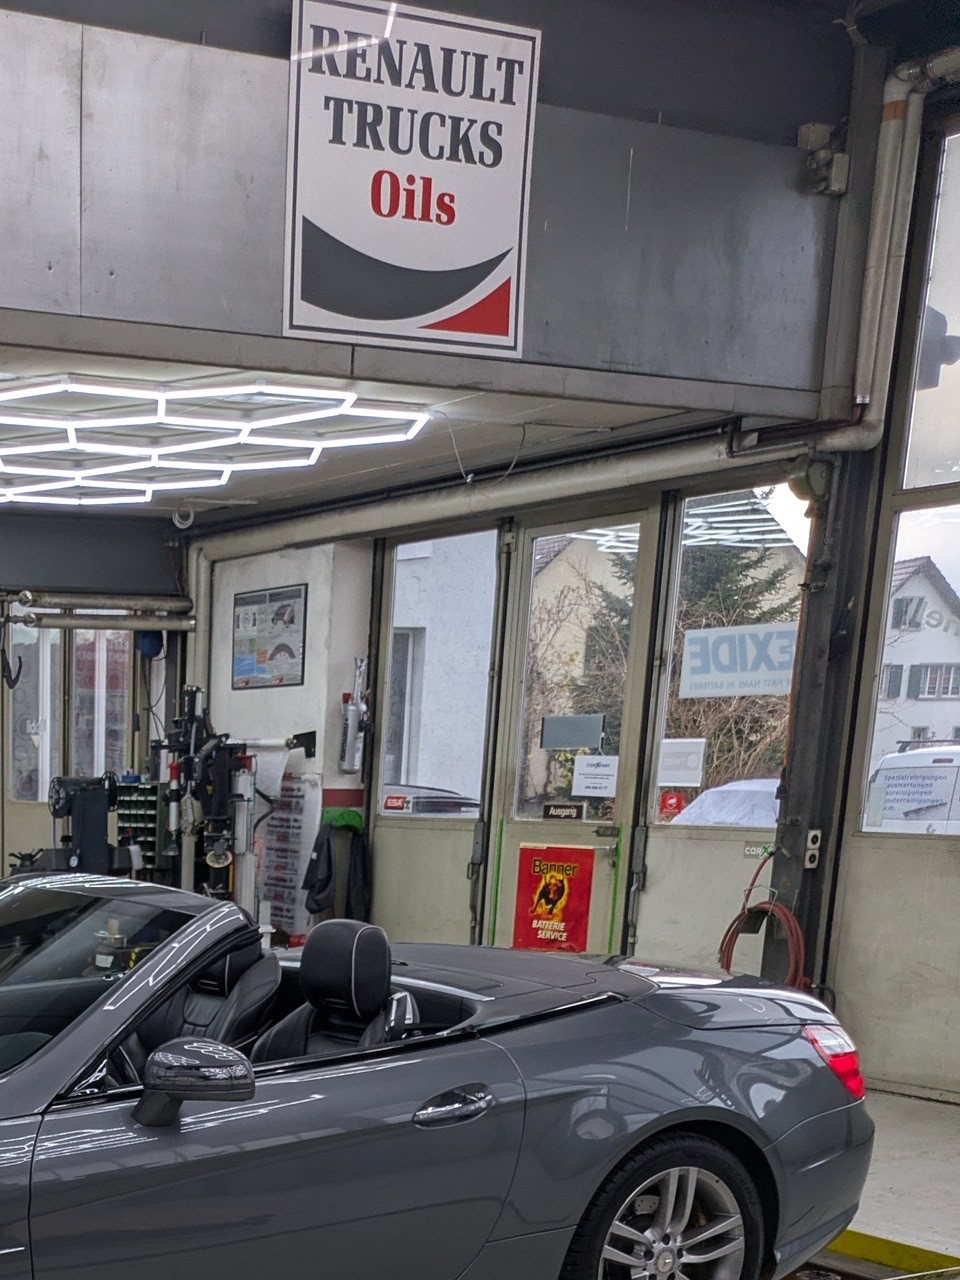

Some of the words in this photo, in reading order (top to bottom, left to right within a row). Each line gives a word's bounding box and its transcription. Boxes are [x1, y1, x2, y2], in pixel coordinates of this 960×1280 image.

[307, 23, 525, 106] RENAULT
[323, 95, 504, 169] TRUCKS
[370, 169, 456, 227] Oils
[548, 806, 577, 818] Ausgang
[532, 857, 578, 876] Banner
[532, 920, 565, 930] BATTERIE
[537, 931, 567, 940] SERVICE
